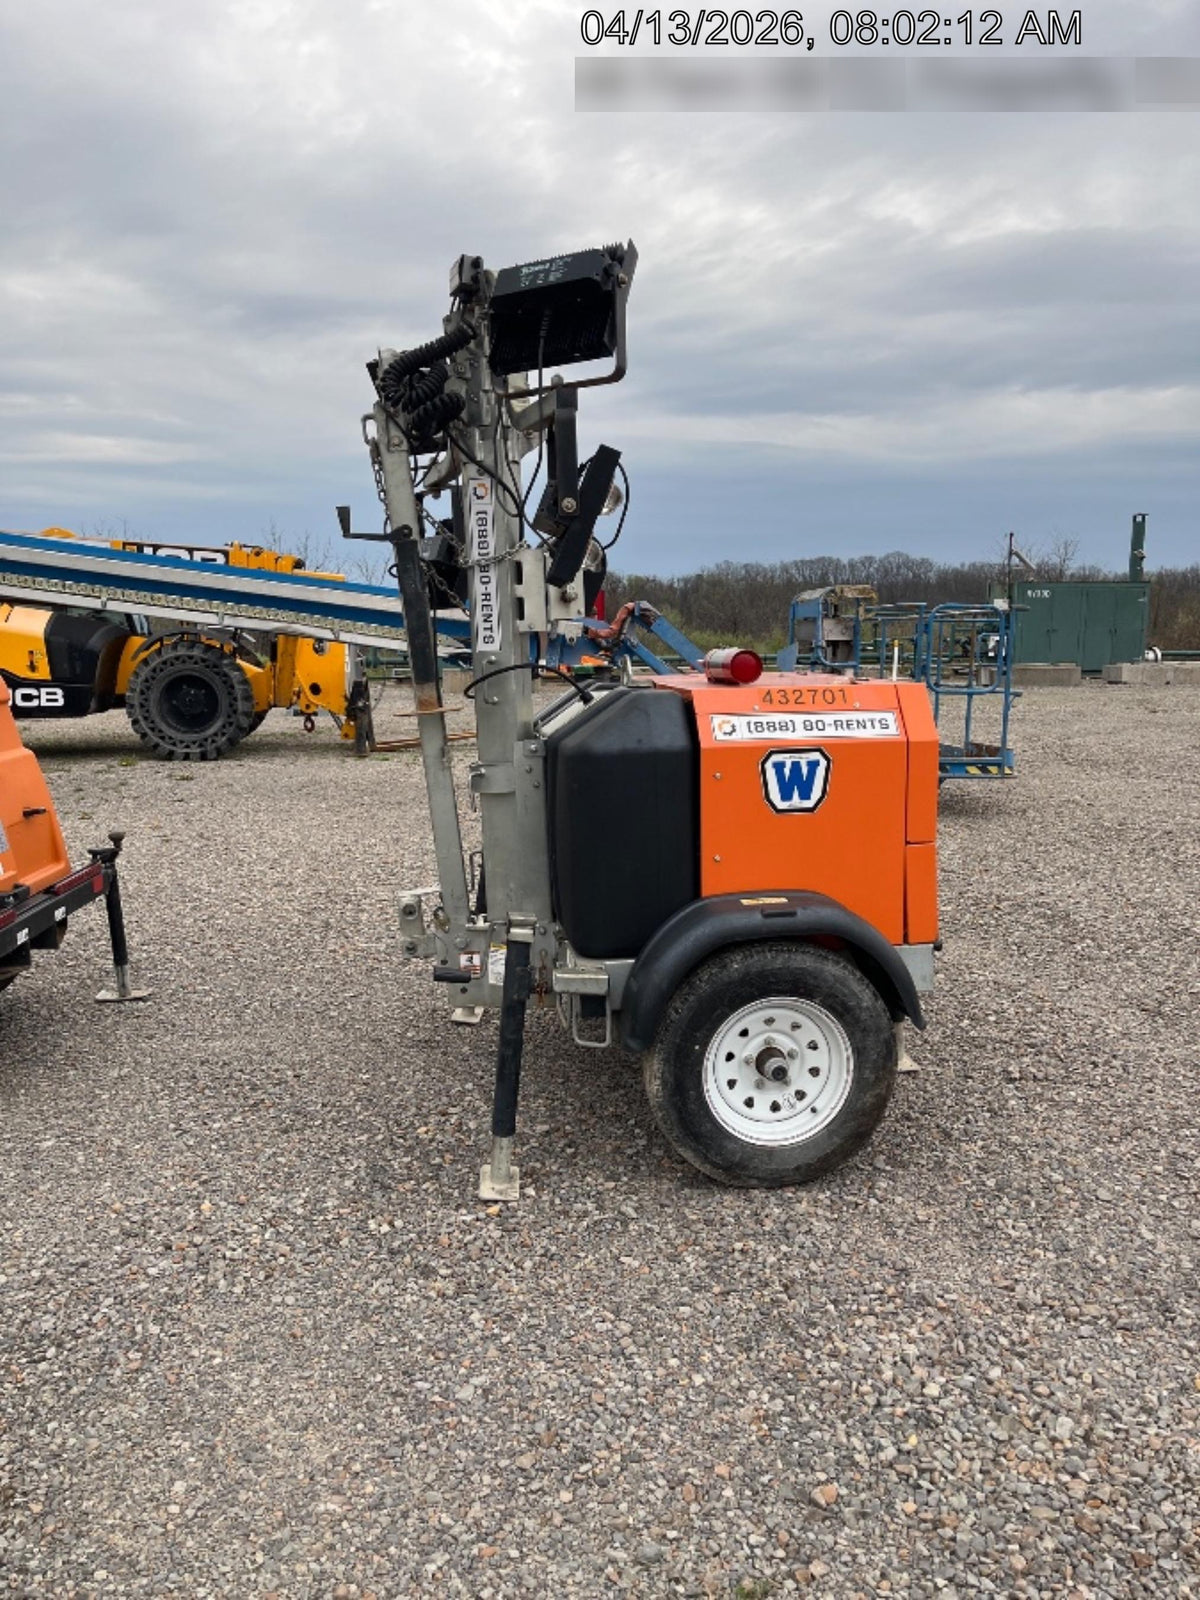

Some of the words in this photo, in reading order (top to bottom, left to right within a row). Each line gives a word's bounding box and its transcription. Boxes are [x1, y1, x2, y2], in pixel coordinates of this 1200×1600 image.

[8, 687, 65, 706] CB
[762, 688, 849, 705] 432701
[771, 759, 821, 802] W
